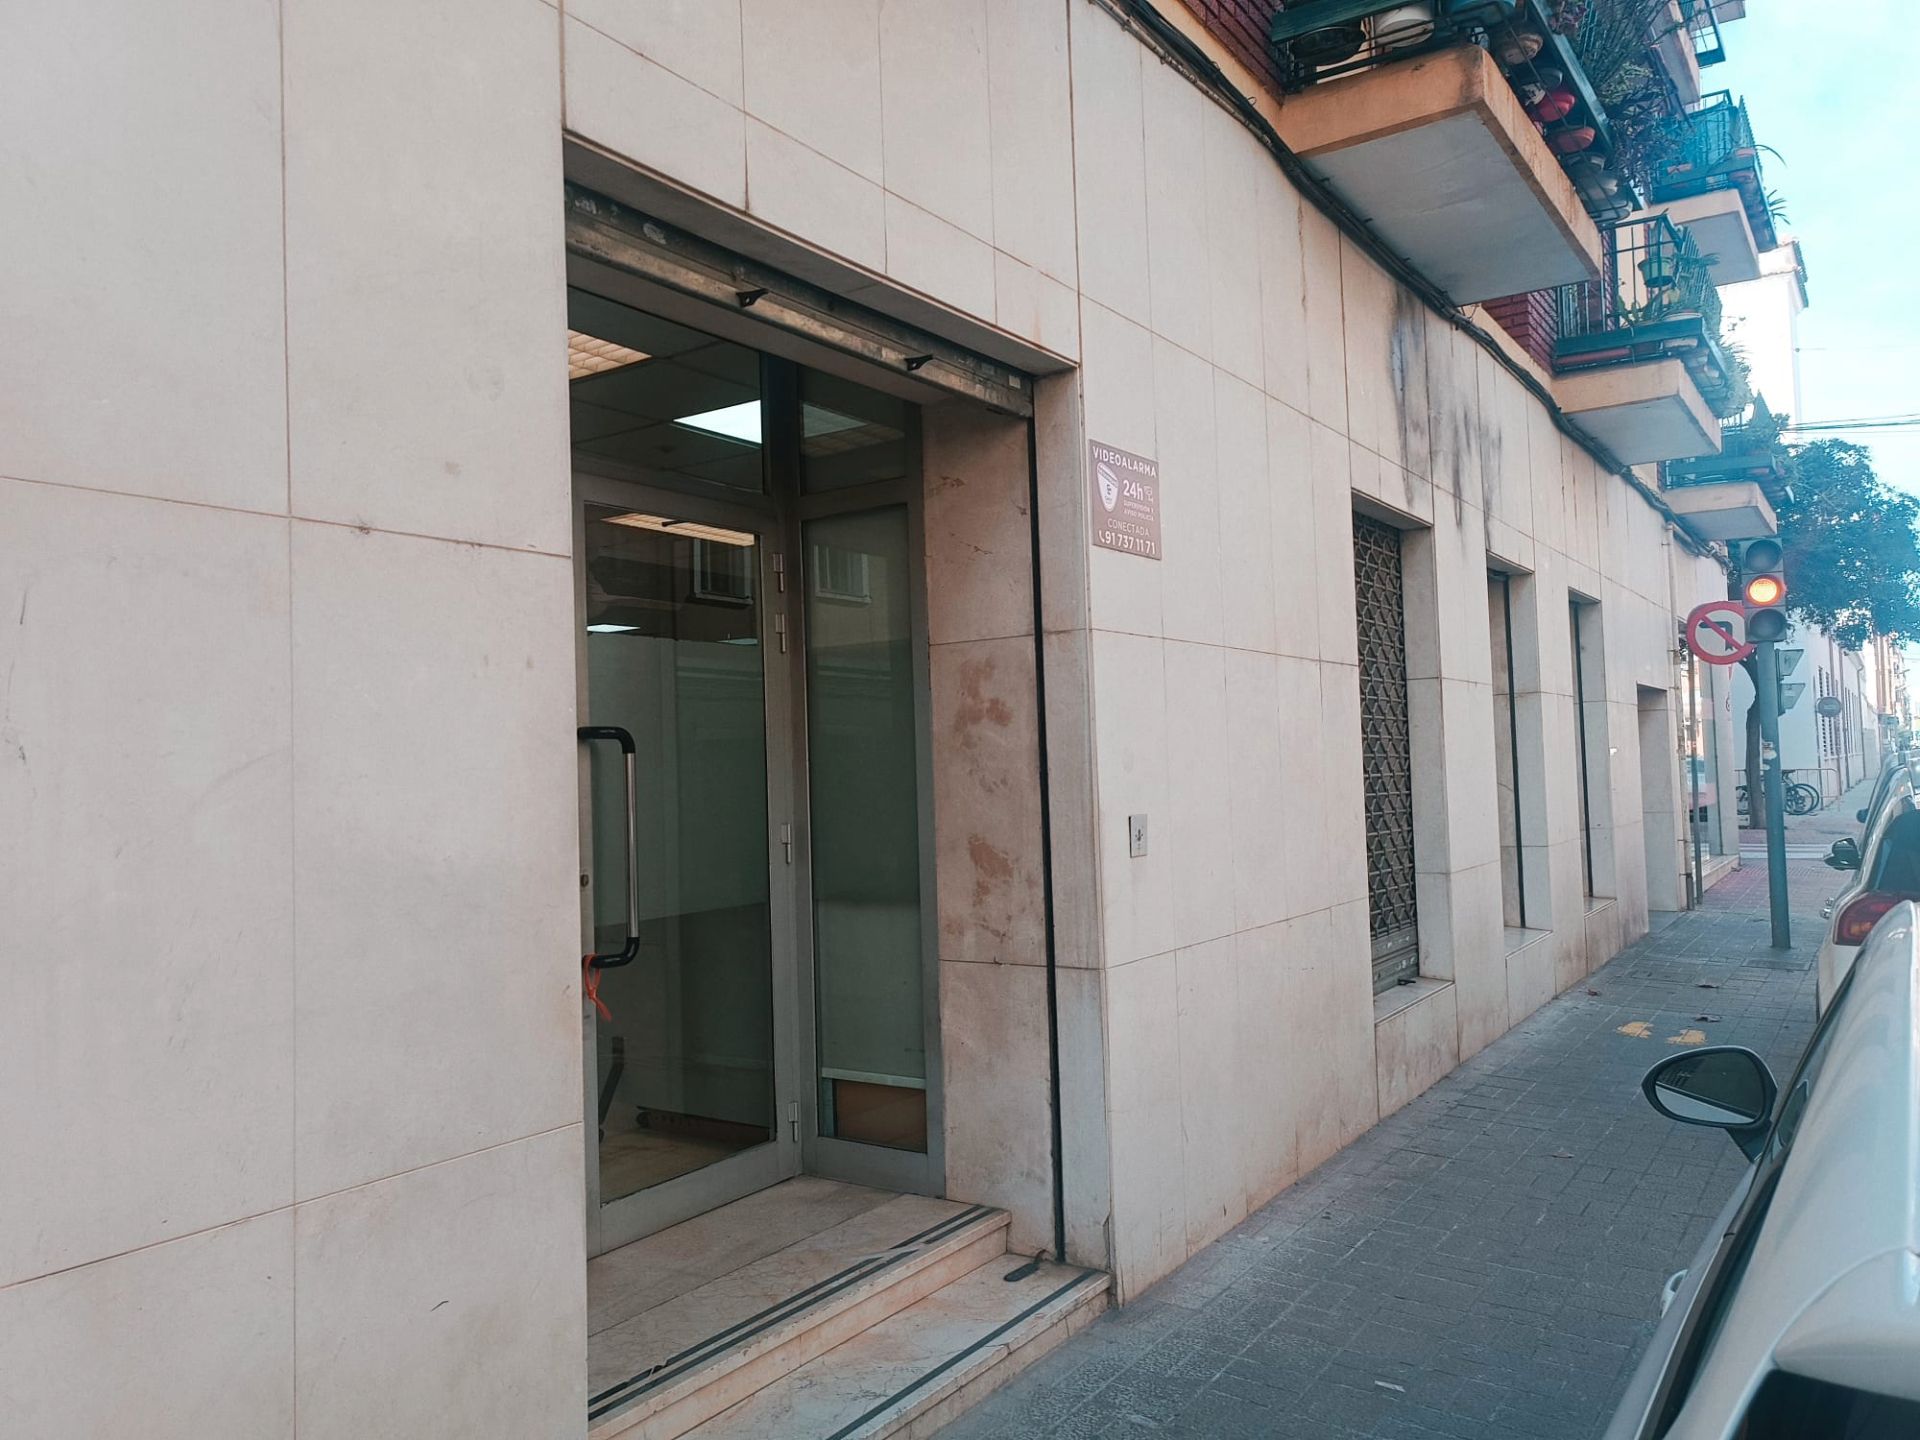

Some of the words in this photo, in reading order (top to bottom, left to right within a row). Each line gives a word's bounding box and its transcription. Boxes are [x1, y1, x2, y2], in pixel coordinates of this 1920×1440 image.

[1092, 446, 1157, 478] VIDEOALARMA
[1123, 480, 1143, 501] 24h
[1107, 518, 1150, 538] CONECTADA
